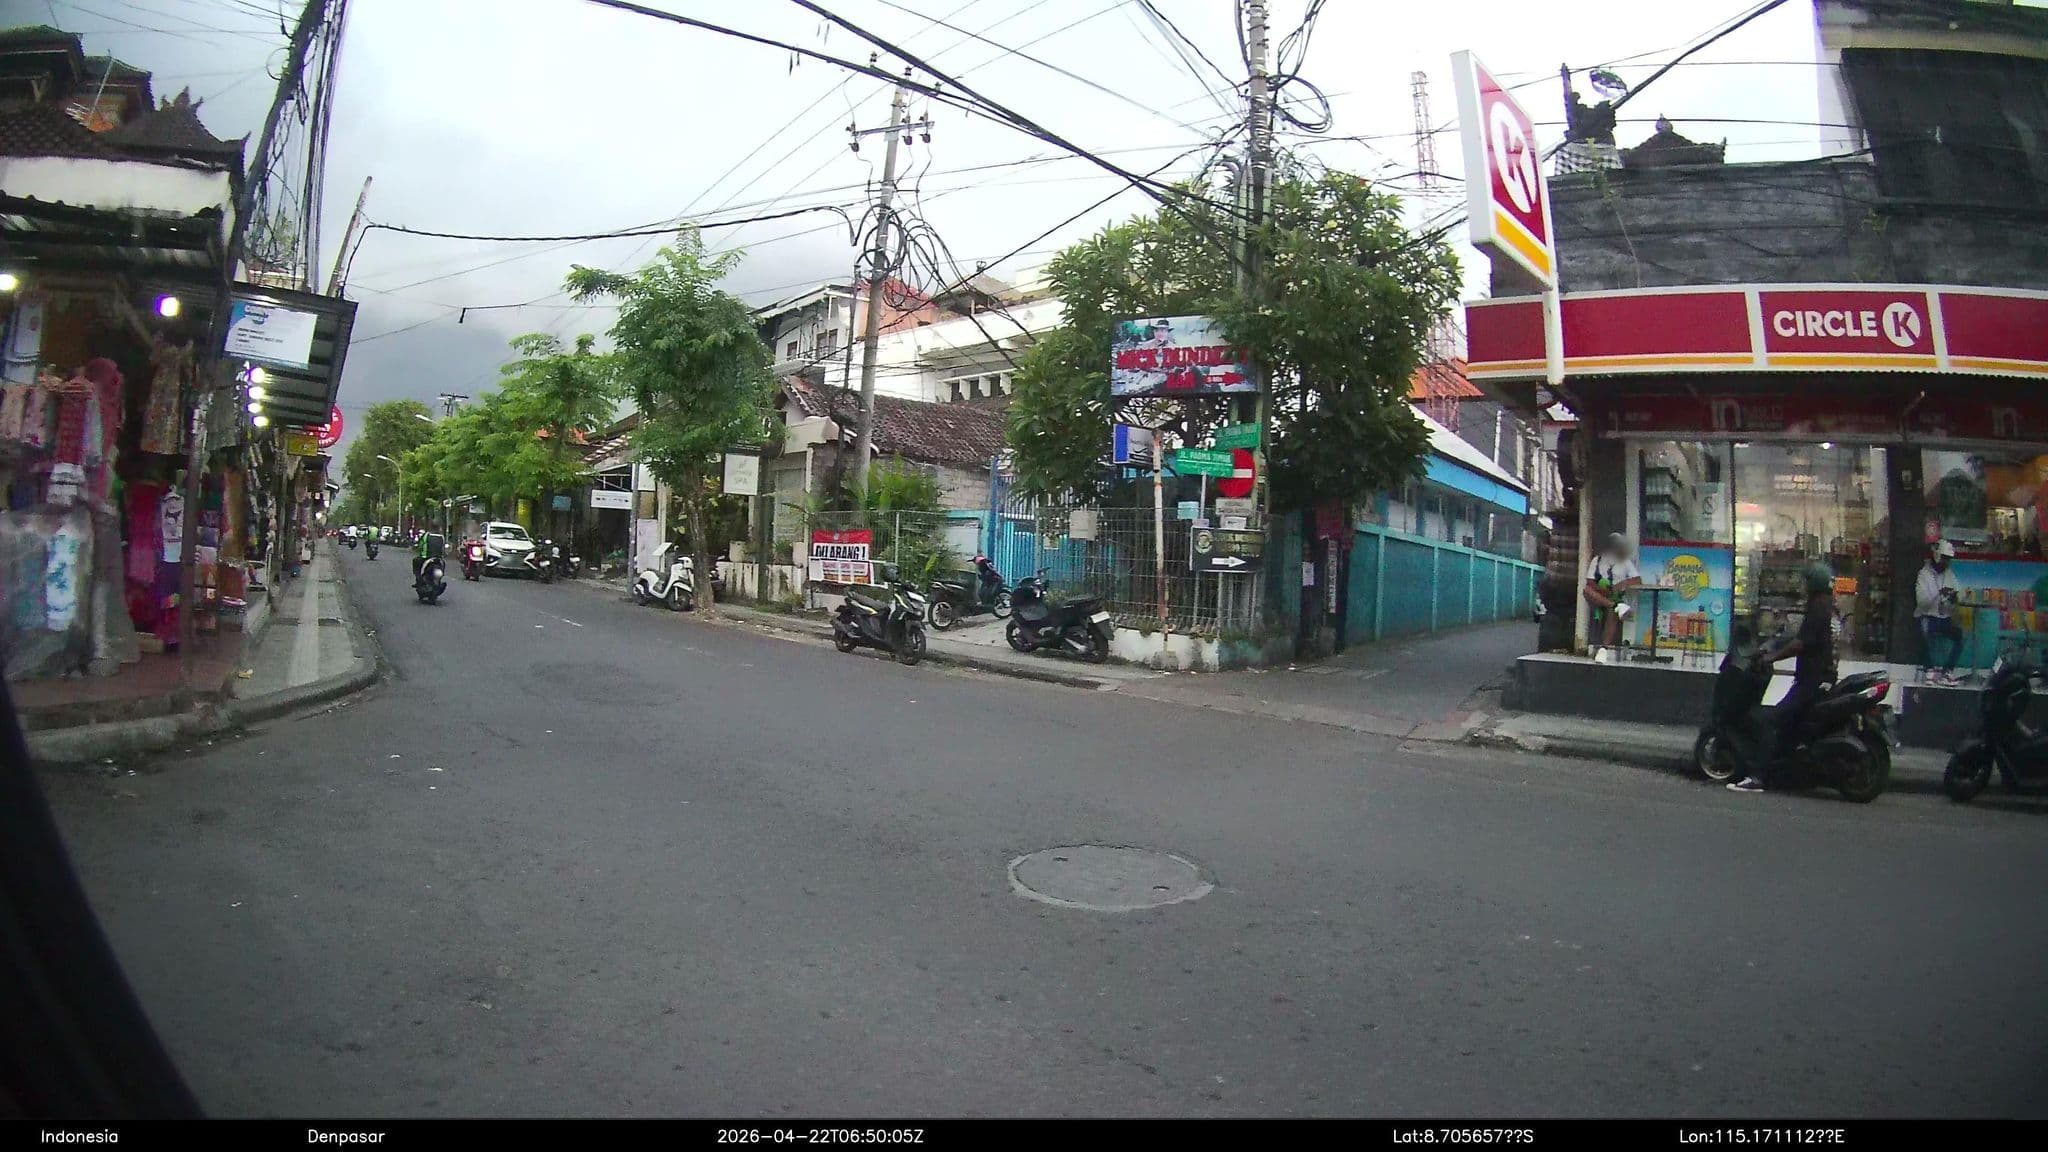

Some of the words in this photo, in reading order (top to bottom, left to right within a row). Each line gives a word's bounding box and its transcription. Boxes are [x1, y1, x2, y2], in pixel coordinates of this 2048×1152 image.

[1497, 110, 1535, 210] K
[1773, 310, 1878, 337] CIRCLE
[1888, 306, 1919, 347] K
